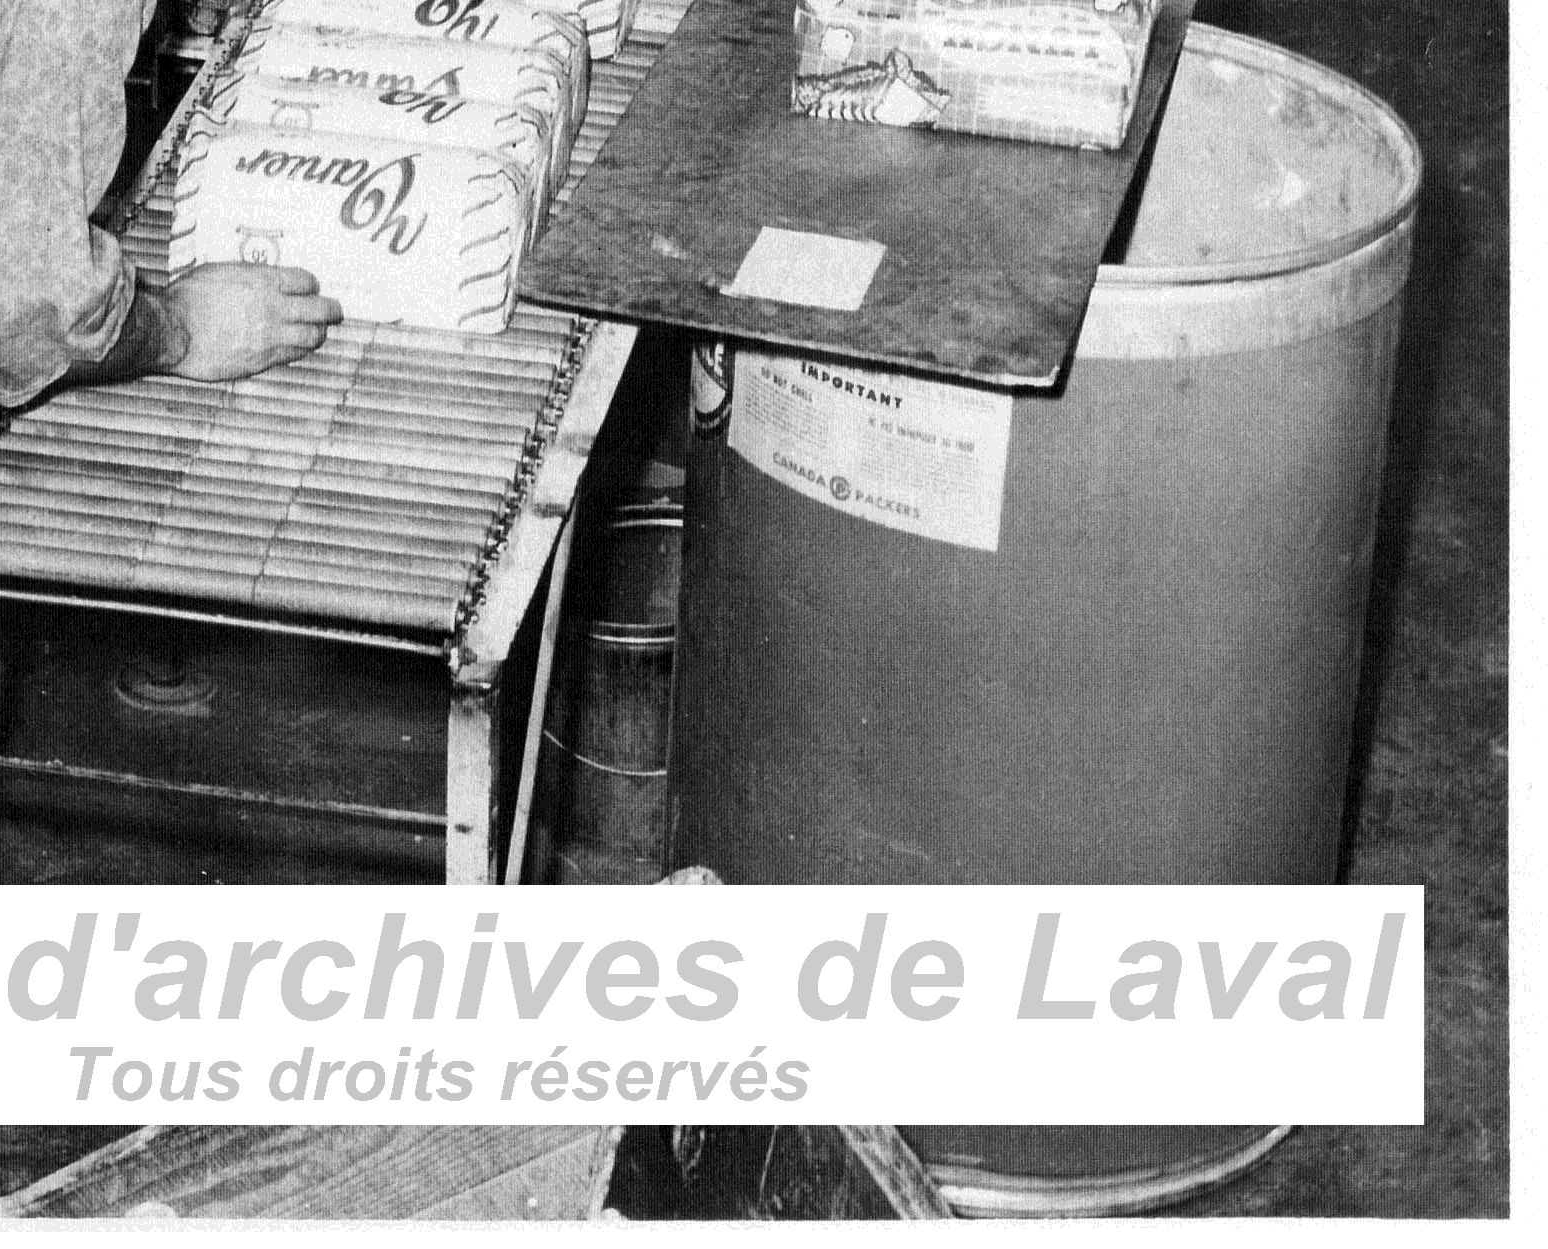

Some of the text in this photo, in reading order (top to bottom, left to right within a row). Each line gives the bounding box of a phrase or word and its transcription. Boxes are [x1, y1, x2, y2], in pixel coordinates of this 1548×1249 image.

[801, 360, 904, 409] IMPORTANT
[772, 451, 826, 488] CANADA
[855, 489, 922, 520] PACKERS
